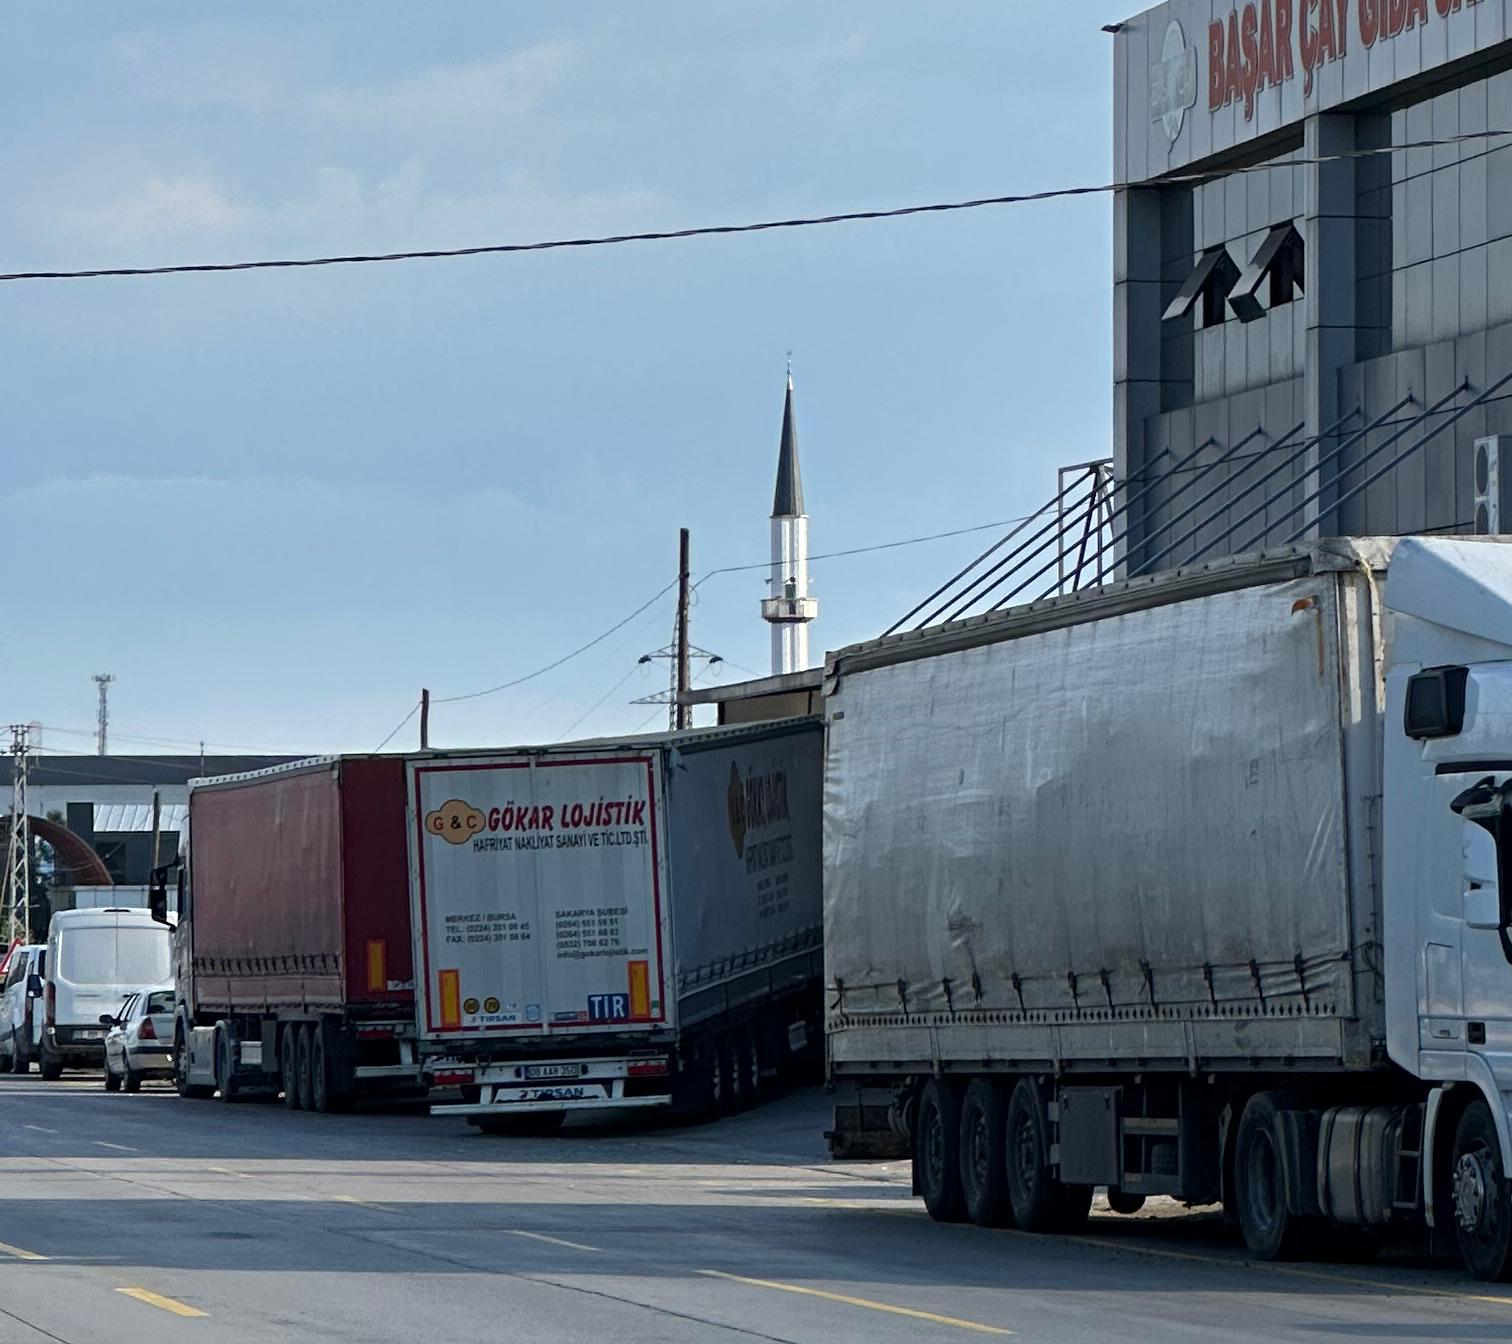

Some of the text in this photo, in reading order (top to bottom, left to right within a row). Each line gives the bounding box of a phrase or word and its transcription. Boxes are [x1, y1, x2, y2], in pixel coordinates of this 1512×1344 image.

[433, 815, 477, 831] G & C
[488, 795, 646, 832] GÖKAR LOJİSTİK
[473, 833, 513, 853] HAFRİYAT
[514, 831, 555, 850] NAKLİYAT
[556, 830, 587, 849] SANAYİ
[587, 832, 600, 847] VE
[555, 909, 595, 918] SAKARYA
[590, 995, 625, 1019] TIR
[479, 1014, 517, 1023] TIRSAN
